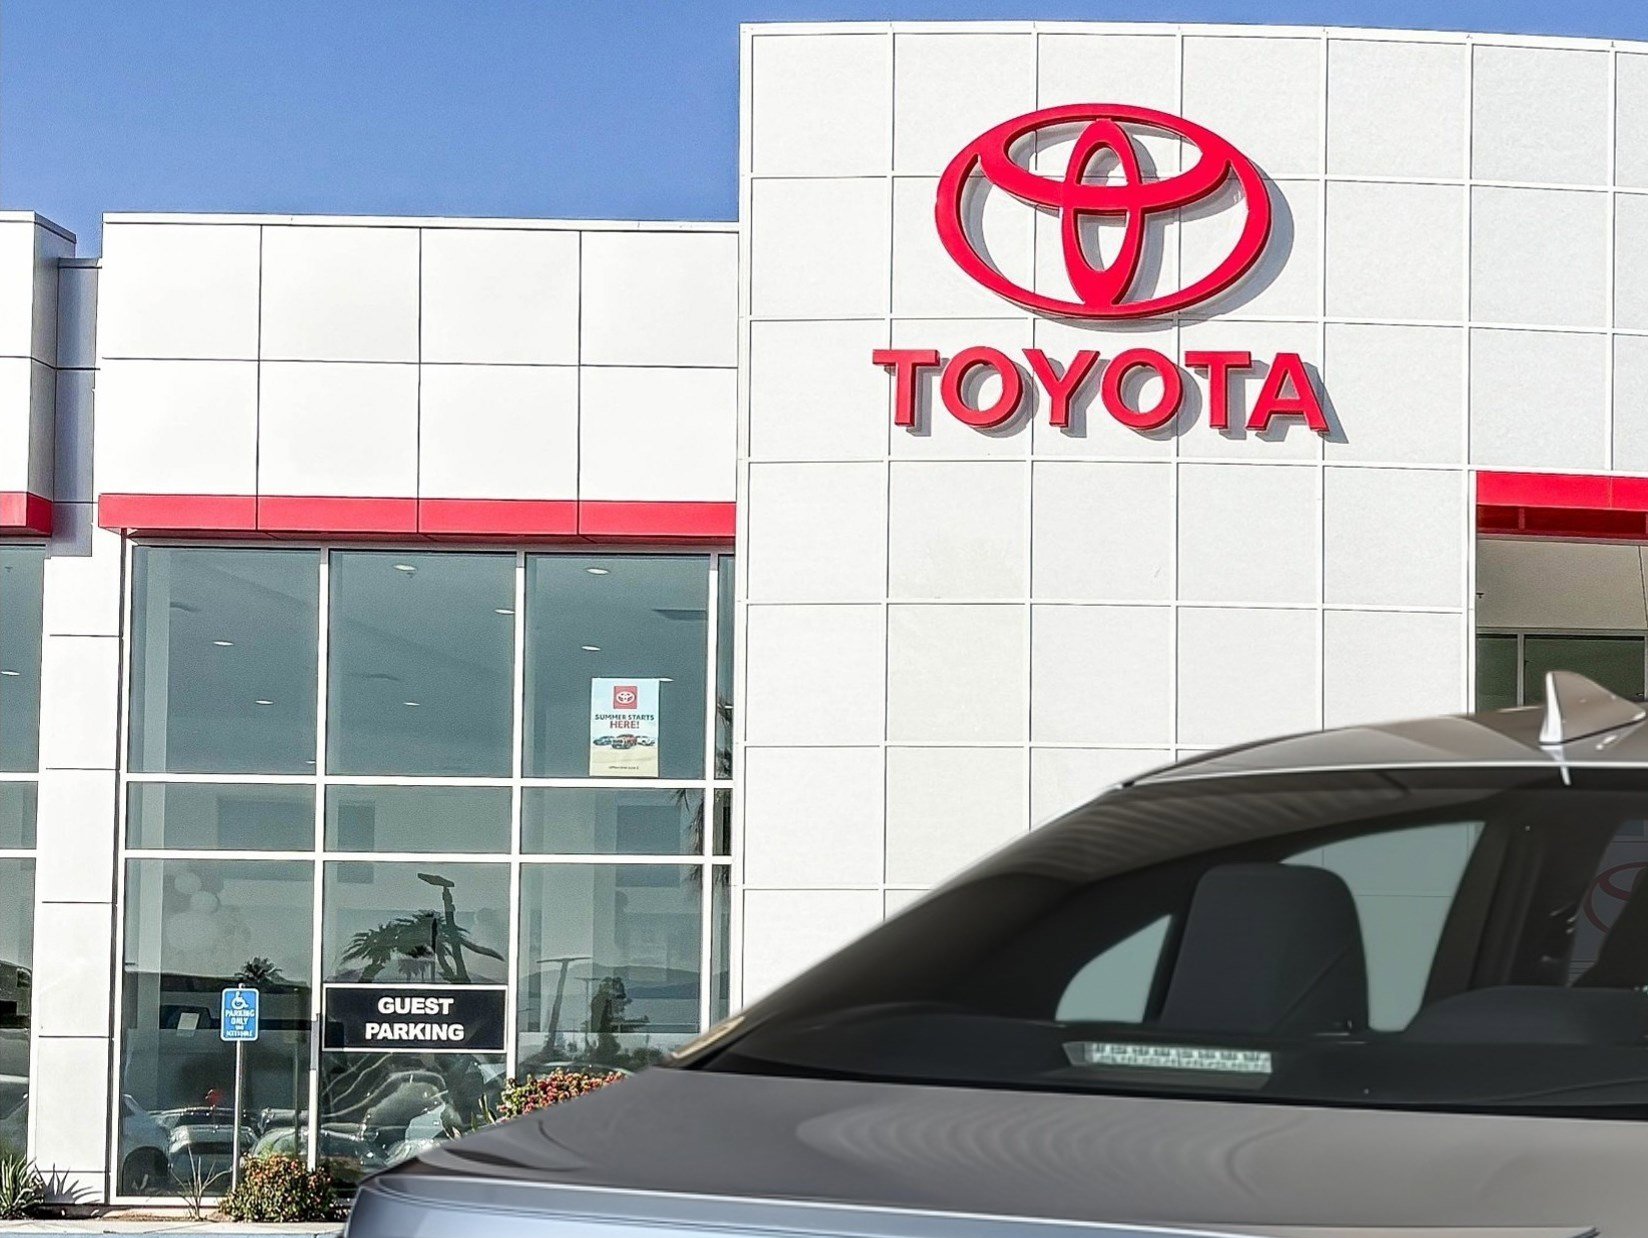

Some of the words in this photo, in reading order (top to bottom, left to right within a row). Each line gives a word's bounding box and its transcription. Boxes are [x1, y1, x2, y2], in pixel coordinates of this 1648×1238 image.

[872, 346, 1329, 432] TOYOTA
[610, 721, 640, 729] HERE!
[378, 997, 454, 1015] GUEST
[365, 1023, 464, 1041] PARKING
